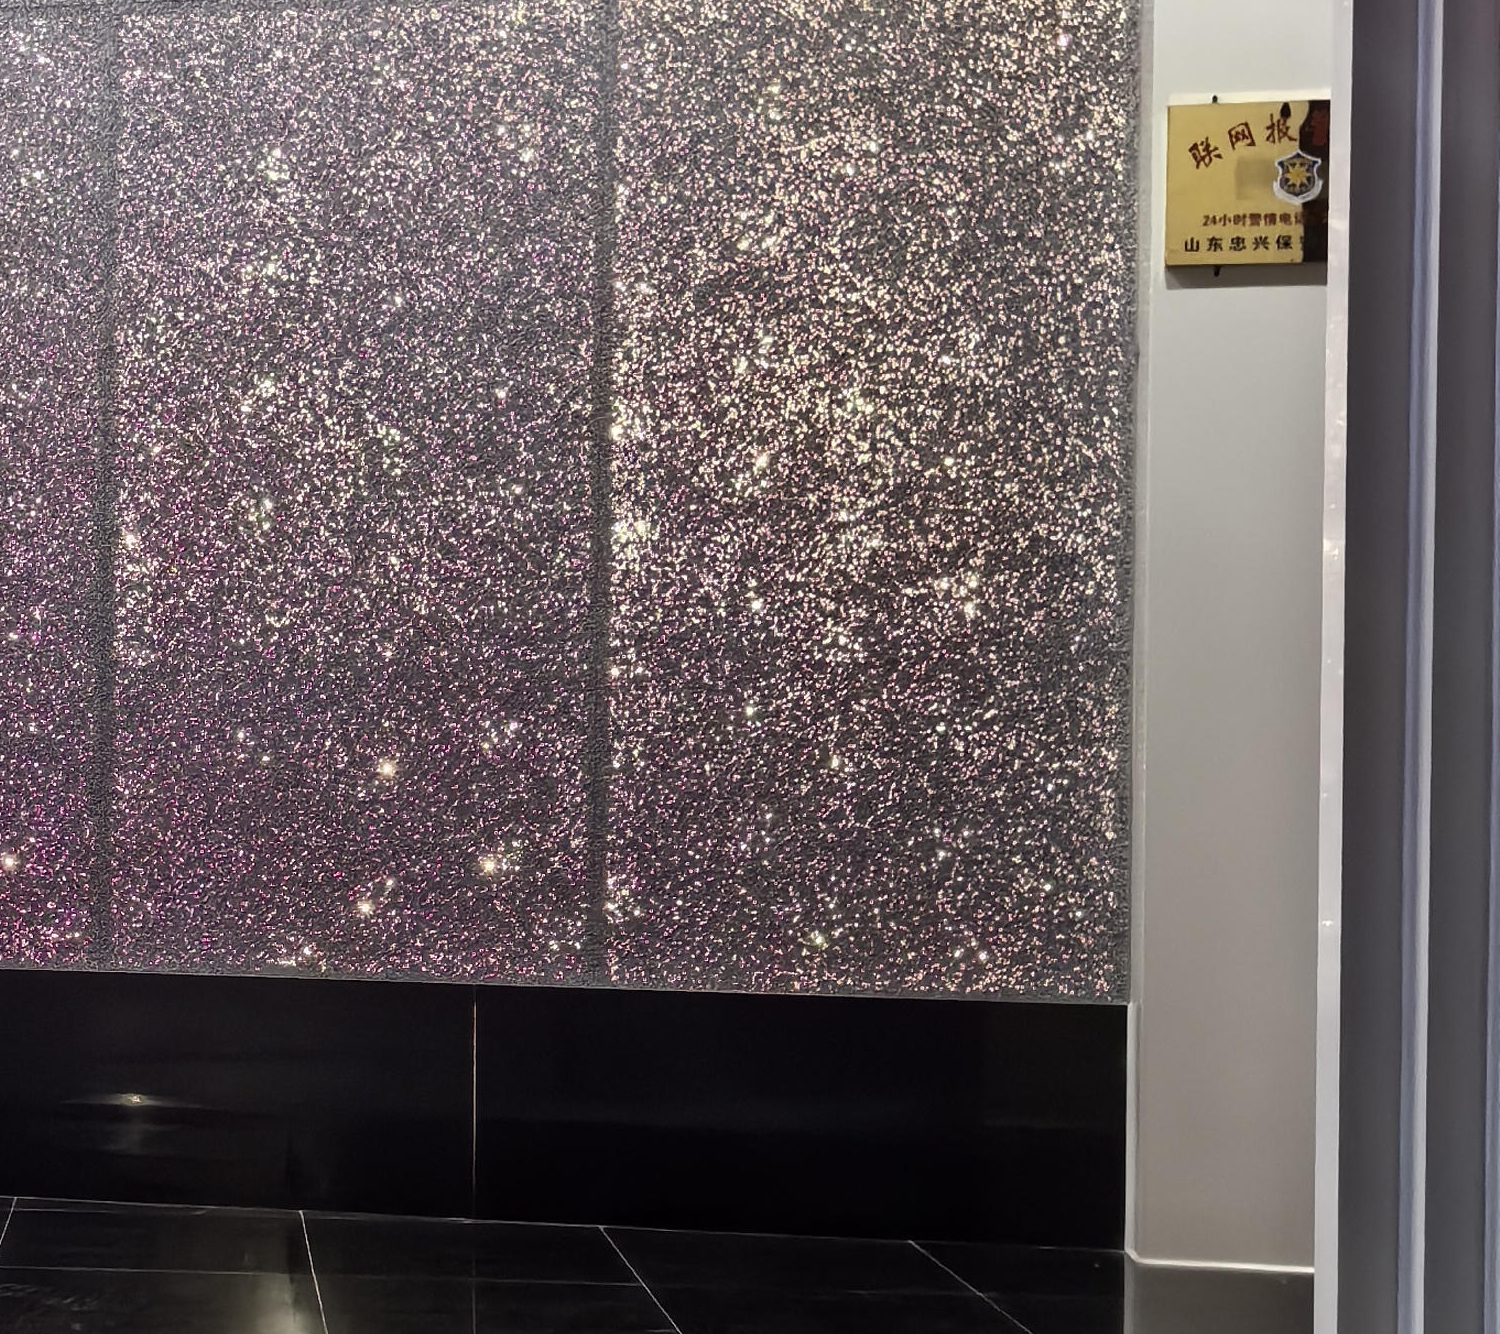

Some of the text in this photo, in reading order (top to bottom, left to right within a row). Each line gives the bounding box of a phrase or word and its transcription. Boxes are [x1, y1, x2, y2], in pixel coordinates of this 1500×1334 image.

[1184, 234, 1303, 253] 山东忠兴保
